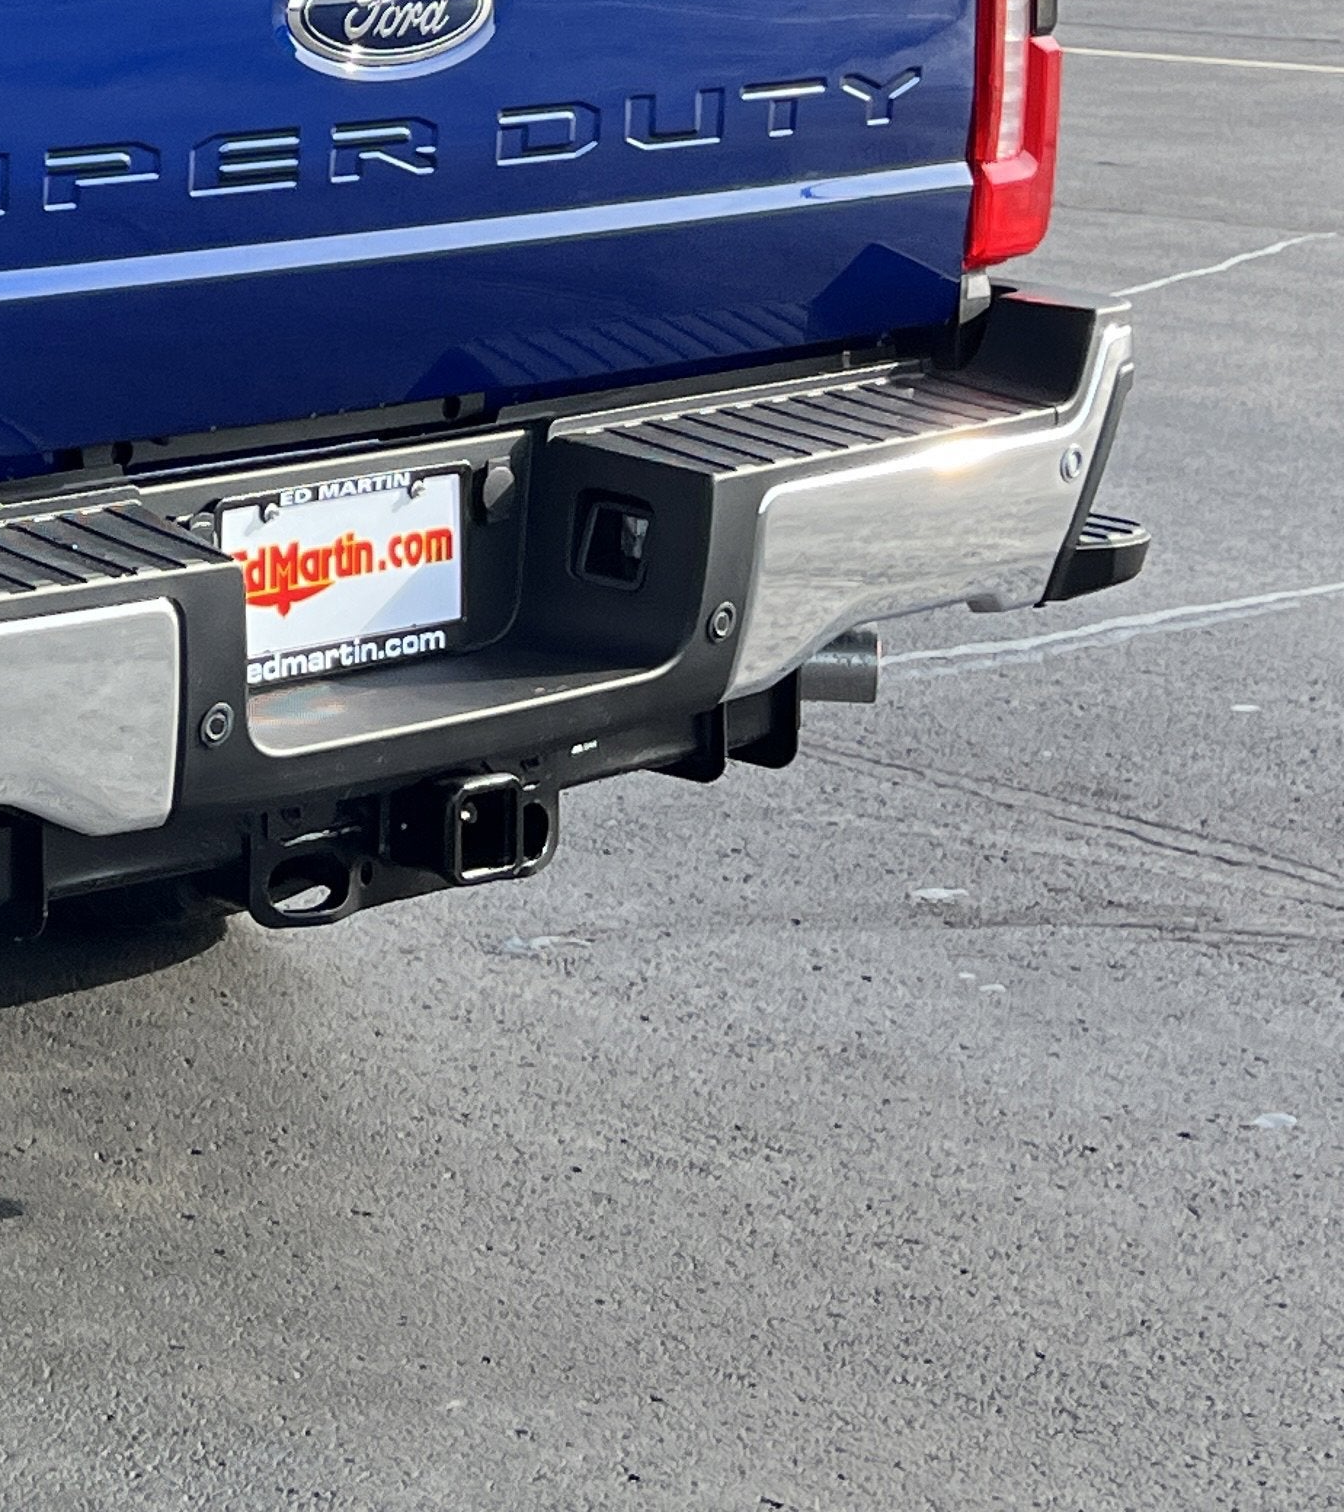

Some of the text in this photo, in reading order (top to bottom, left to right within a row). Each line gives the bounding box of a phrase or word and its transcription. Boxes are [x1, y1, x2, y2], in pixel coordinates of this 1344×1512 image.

[496, 65, 924, 167] DUTY
[280, 471, 412, 507] ED MARTIN
[232, 526, 454, 595] dMartin.com
[246, 629, 446, 685] edmartin.com
